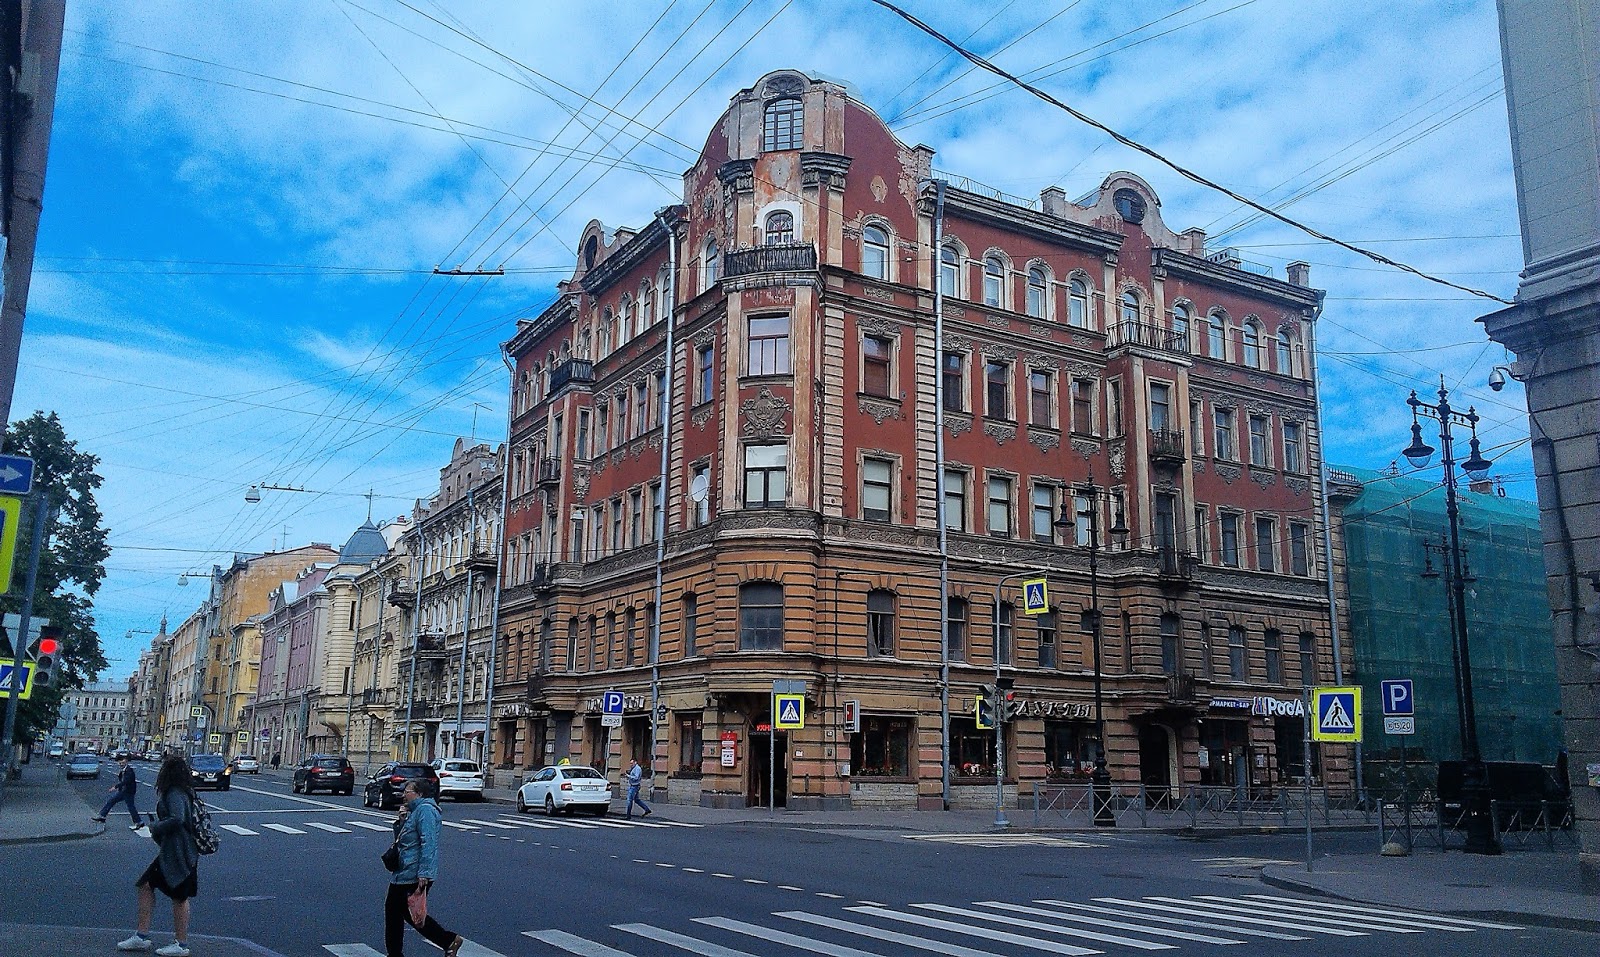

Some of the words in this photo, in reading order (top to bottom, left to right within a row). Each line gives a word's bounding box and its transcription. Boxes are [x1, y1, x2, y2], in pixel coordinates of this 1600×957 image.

[608, 694, 621, 712] P
[1390, 684, 1408, 711] P
[1402, 721, 1411, 730] 20
